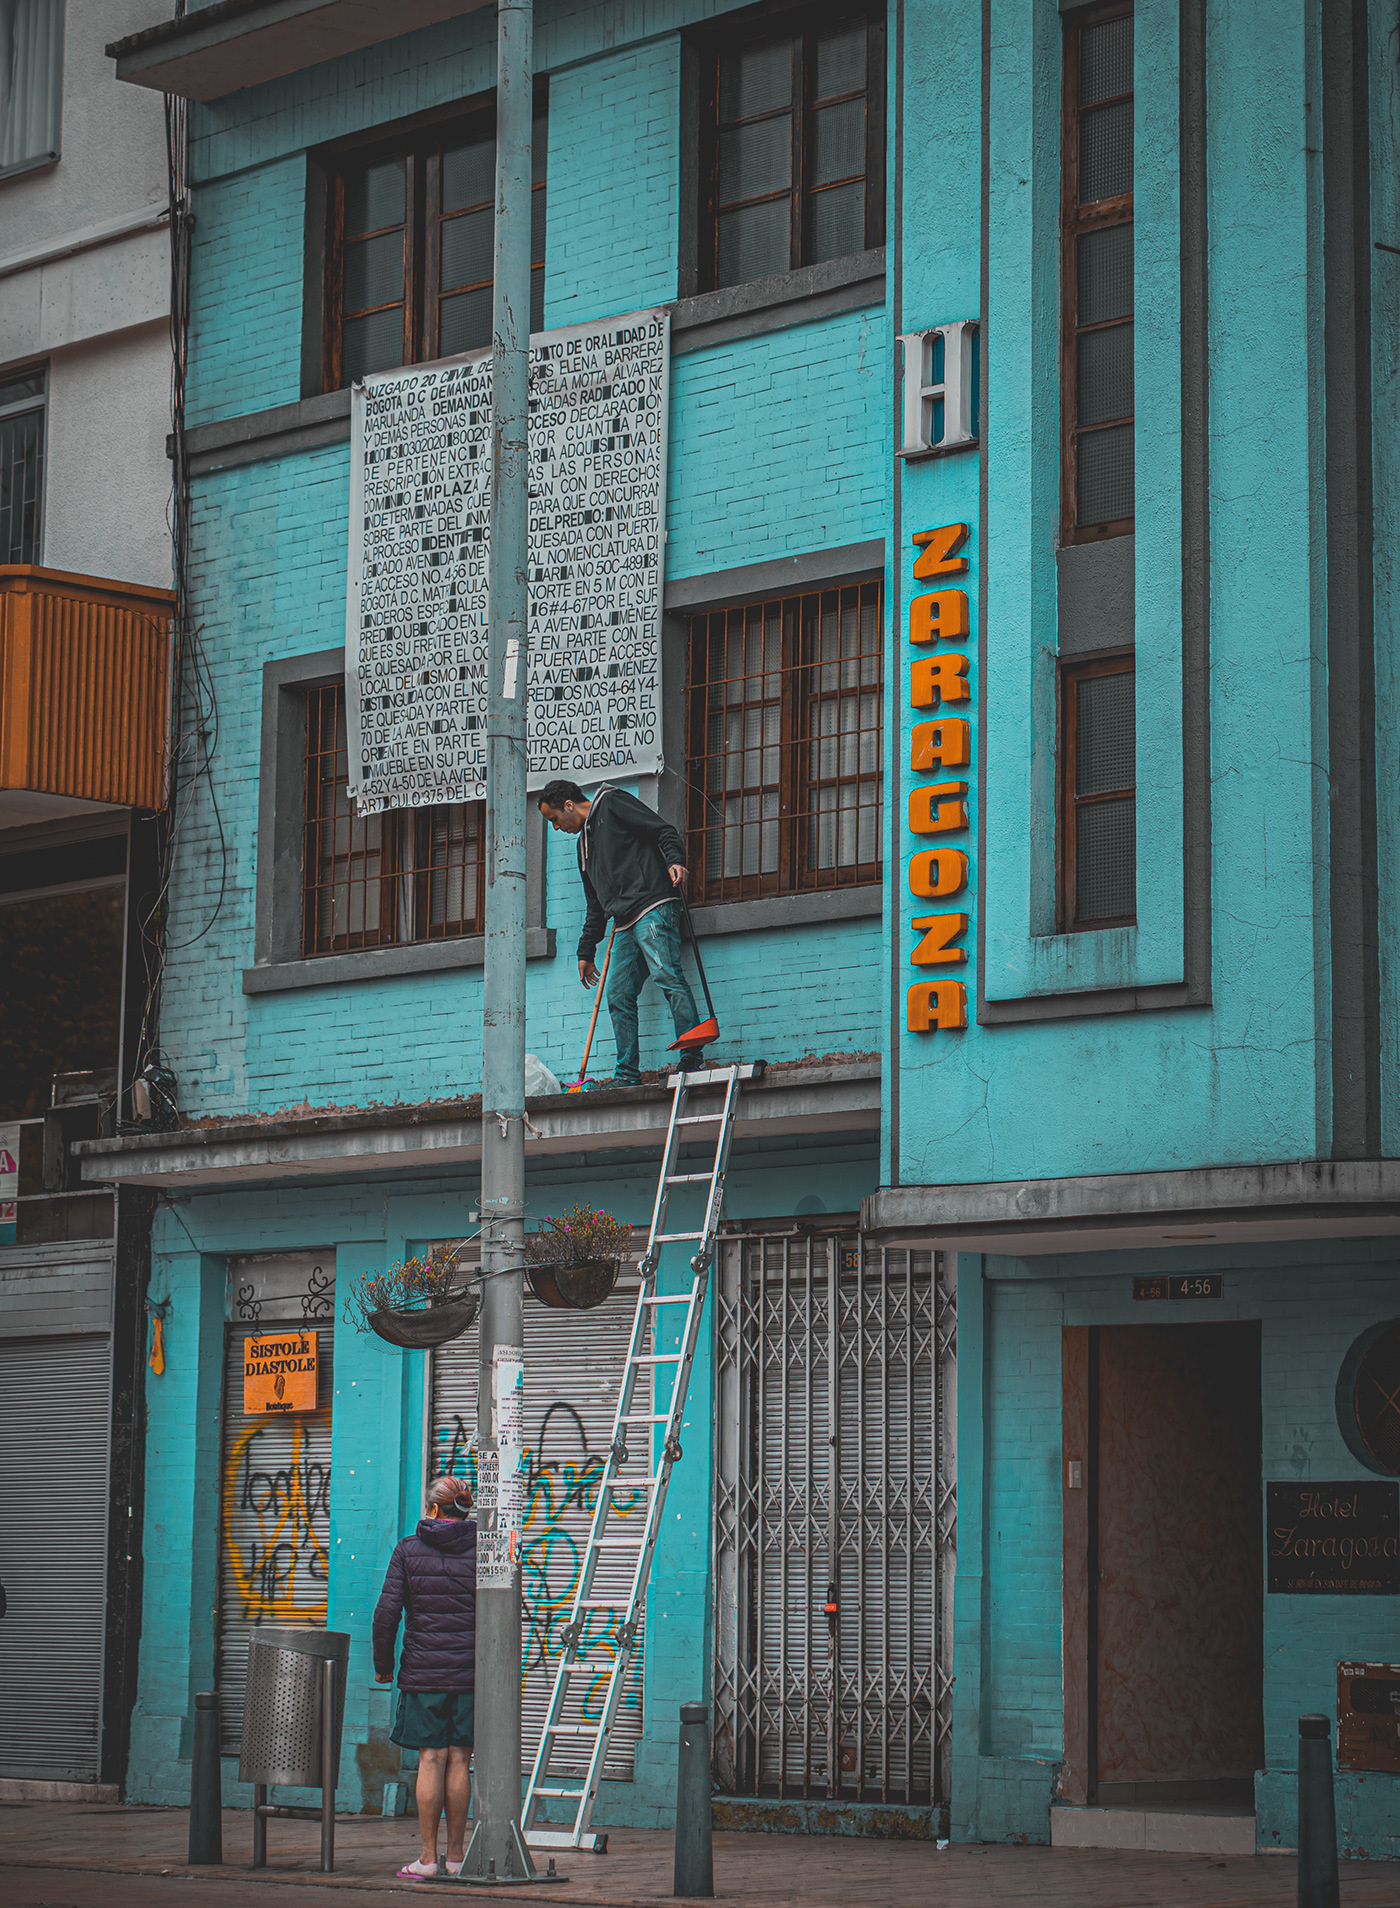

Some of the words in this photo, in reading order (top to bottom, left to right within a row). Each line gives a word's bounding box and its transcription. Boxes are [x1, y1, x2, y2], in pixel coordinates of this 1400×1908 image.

[366, 377, 418, 400] JUZGADO
[420, 374, 436, 387] 20
[567, 340, 582, 356] DE
[649, 322, 663, 338] DE
[366, 396, 402, 416] BOGOTA
[431, 375, 493, 400] DEMANDAN
[560, 354, 598, 375] ELENA
[605, 340, 663, 366] BARRERA
[365, 406, 425, 433] MARULANDA
[572, 370, 607, 390] MOTTA
[895, 318, 980, 458] H
[364, 436, 372, 448] Y
[411, 413, 466, 438] PERSONAS
[364, 466, 379, 482] DE
[415, 479, 478, 503] EMPLAZA
[552, 461, 576, 478] LAS
[584, 446, 660, 472] PERSONAS
[561, 476, 587, 493] CON
[594, 464, 659, 488] DERECHOS
[364, 527, 395, 547] SOBRE
[400, 520, 433, 539] PARTE
[438, 516, 462, 532] DEL
[530, 498, 560, 515] PARA
[563, 494, 585, 510] QUE
[373, 539, 419, 561] PROCESO
[530, 517, 553, 532] DEL
[586, 524, 612, 541] CON
[361, 581, 373, 596] DE
[374, 573, 418, 592] ACCESO
[469, 561, 485, 577] DE
[548, 538, 644, 564] NOMENCLATURA
[576, 580, 590, 596] EN
[593, 578, 602, 593] 5
[606, 577, 615, 592] M
[620, 572, 644, 590] CON
[578, 562, 593, 578] NO
[461, 613, 476, 628] EN
[619, 592, 631, 608] EL
[359, 646, 378, 662] QUE
[381, 644, 393, 659] ES
[395, 641, 411, 657] SU
[454, 631, 468, 646] EN
[359, 664, 372, 679] DE
[427, 650, 452, 668] POR
[457, 649, 470, 663] EL
[541, 635, 560, 650] EN
[567, 630, 607, 648] PARTE
[612, 626, 638, 643] CON
[643, 623, 656, 638] EL
[361, 677, 393, 696] LOCAL
[534, 650, 587, 668] PUERTA
[590, 647, 606, 663] DE
[361, 714, 374, 730] DE
[425, 704, 434, 718] Y
[436, 700, 475, 717] PARTE
[584, 682, 608, 698] NOS
[425, 685, 450, 701] CON
[454, 682, 469, 697] EL
[361, 731, 372, 746] 70
[375, 729, 390, 744] DE
[534, 700, 601, 720] QUESADA
[608, 697, 636, 713] POR
[640, 694, 656, 710] EL
[414, 738, 429, 754] EN
[436, 733, 480, 751] PARTE
[528, 721, 577, 737] LOCAL
[582, 717, 605, 734] DEL
[418, 755, 433, 771] EN
[436, 753, 453, 768] SU
[583, 734, 610, 751] CON
[634, 730, 654, 746] NO
[418, 772, 432, 788] DE
[550, 755, 569, 771] DE
[907, 522, 970, 1033] ZARAGOZA
[423, 788, 444, 804] 375
[446, 785, 470, 800] DEL
[1181, 1279, 1211, 1294] 4-56
[246, 1358, 315, 1376] DIASTOLE
[251, 1341, 309, 1358] SISTOLE
[1300, 1493, 1357, 1517] Hotel
[1271, 1526, 1397, 1569] Zaragoza
